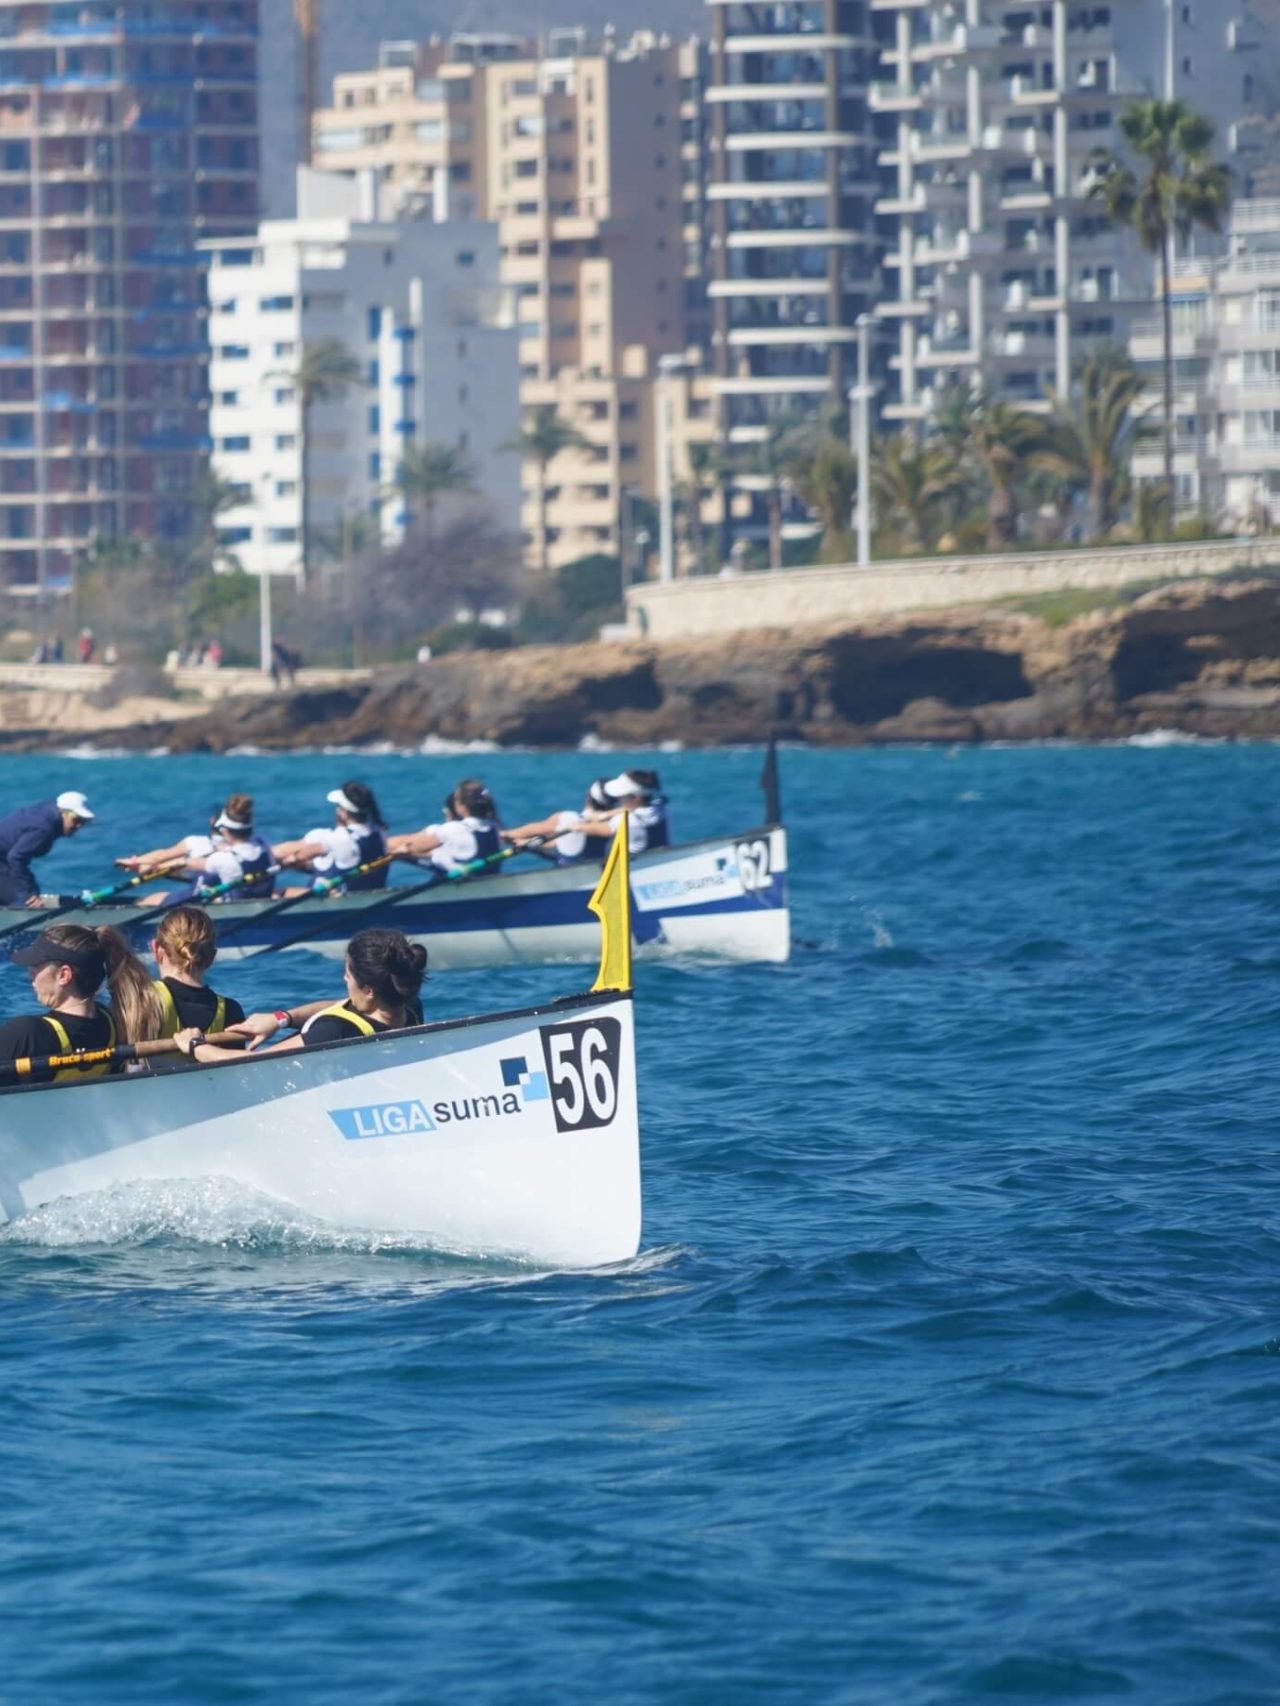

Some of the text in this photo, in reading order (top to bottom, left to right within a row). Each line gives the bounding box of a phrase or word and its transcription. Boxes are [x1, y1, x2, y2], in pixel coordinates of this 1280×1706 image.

[736, 840, 773, 890] 62
[549, 1027, 616, 1125] 56
[354, 1092, 522, 1136] LIGA suma
